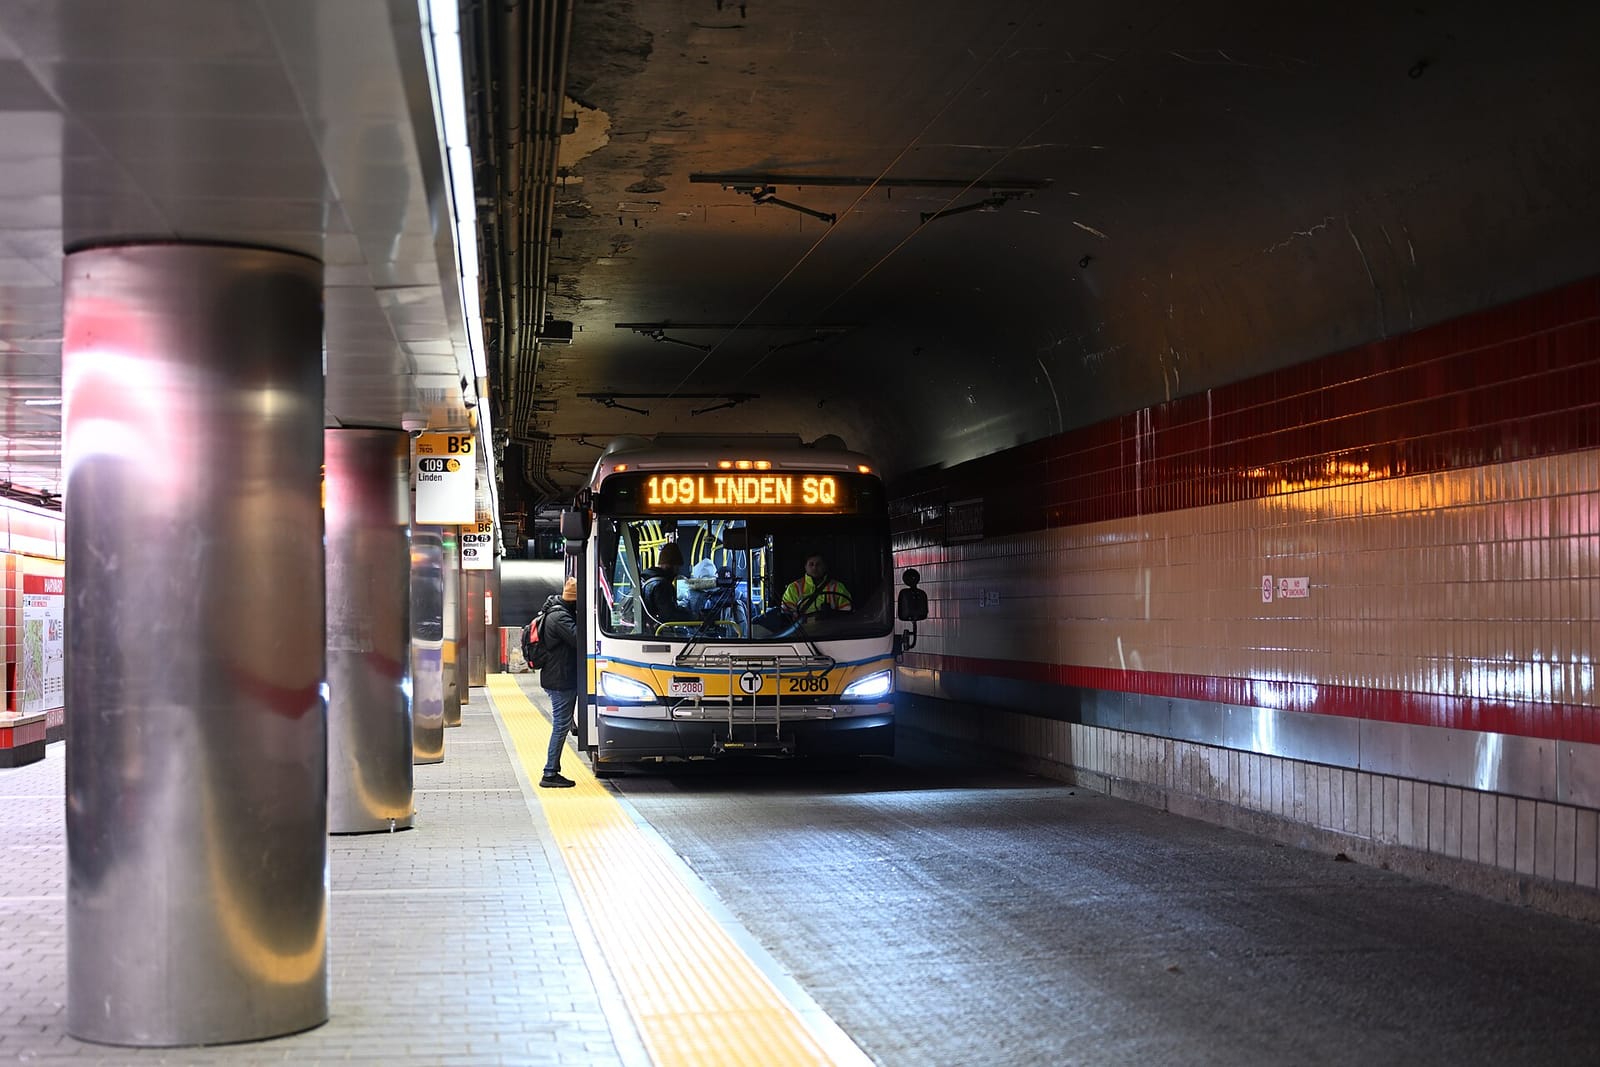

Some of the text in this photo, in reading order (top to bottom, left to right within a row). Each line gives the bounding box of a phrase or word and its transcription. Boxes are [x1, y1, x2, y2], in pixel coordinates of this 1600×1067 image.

[447, 436, 471, 454] B5
[424, 459, 443, 471] 109
[418, 473, 443, 481] Linden
[648, 477, 836, 505] 109 LINDEN SQ
[478, 522, 491, 532] B6
[44, 578, 63, 592] HARVARD
[682, 682, 703, 693] 2080
[789, 678, 829, 692] 2080
